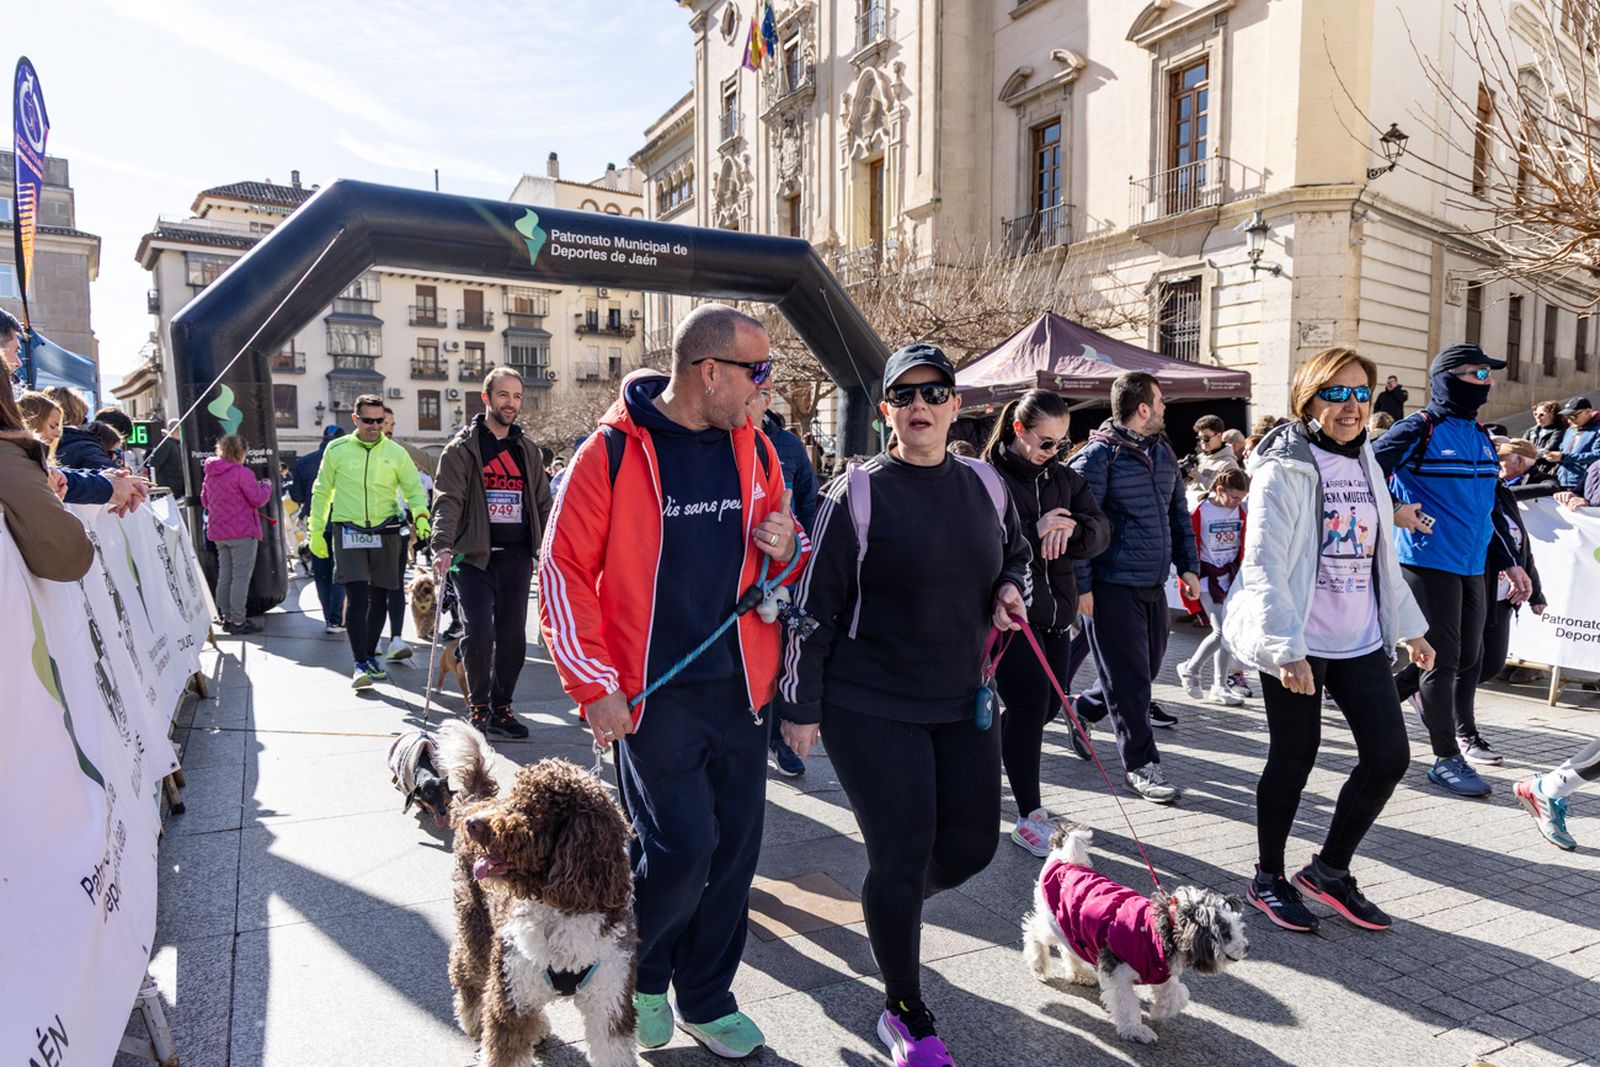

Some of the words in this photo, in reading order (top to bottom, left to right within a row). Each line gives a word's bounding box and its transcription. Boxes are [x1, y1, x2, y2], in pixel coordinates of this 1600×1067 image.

[550, 229, 611, 247] Patronato
[614, 236, 670, 254] Municipal
[673, 244, 688, 255] de
[550, 243, 608, 261] Deportes
[610, 251, 626, 263] de
[628, 253, 657, 266] Jaén
[192, 450, 215, 459] Patron
[490, 504, 513, 516] 949
[684, 500, 718, 516] sans
[351, 534, 374, 544] 1160
[1215, 532, 1235, 542] 930
